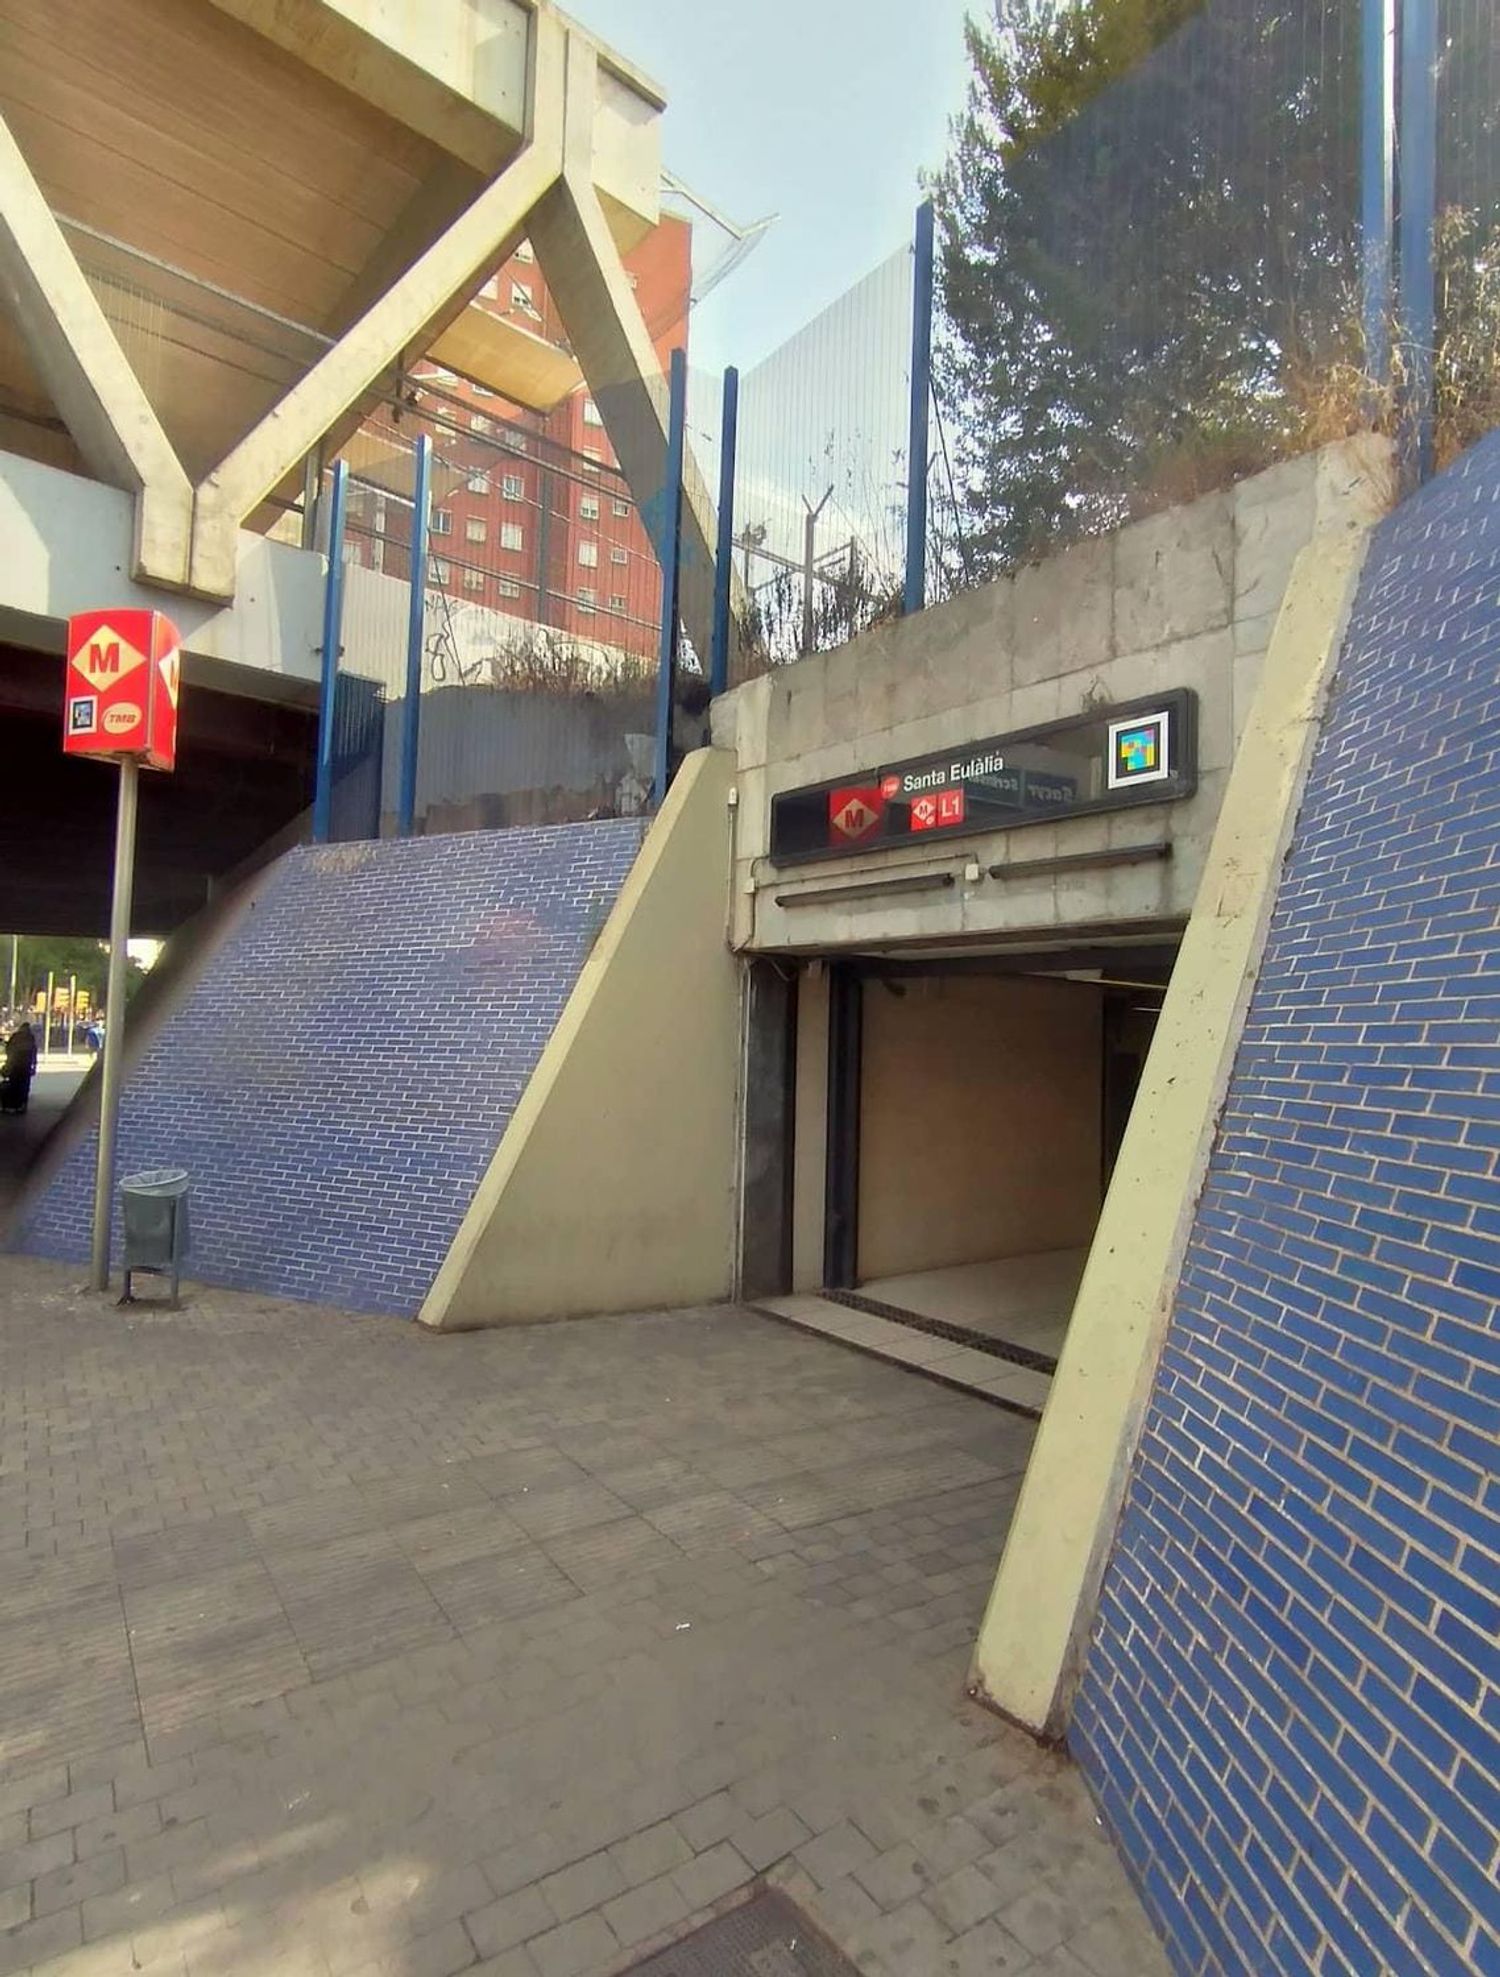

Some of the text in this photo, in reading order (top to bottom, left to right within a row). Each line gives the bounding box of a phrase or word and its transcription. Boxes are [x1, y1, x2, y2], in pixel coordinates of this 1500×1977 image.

[90, 643, 120, 674] M
[109, 712, 136, 724] TMB
[903, 770, 946, 792] Santa
[941, 795, 960, 817] L1
[845, 807, 865, 828] M
